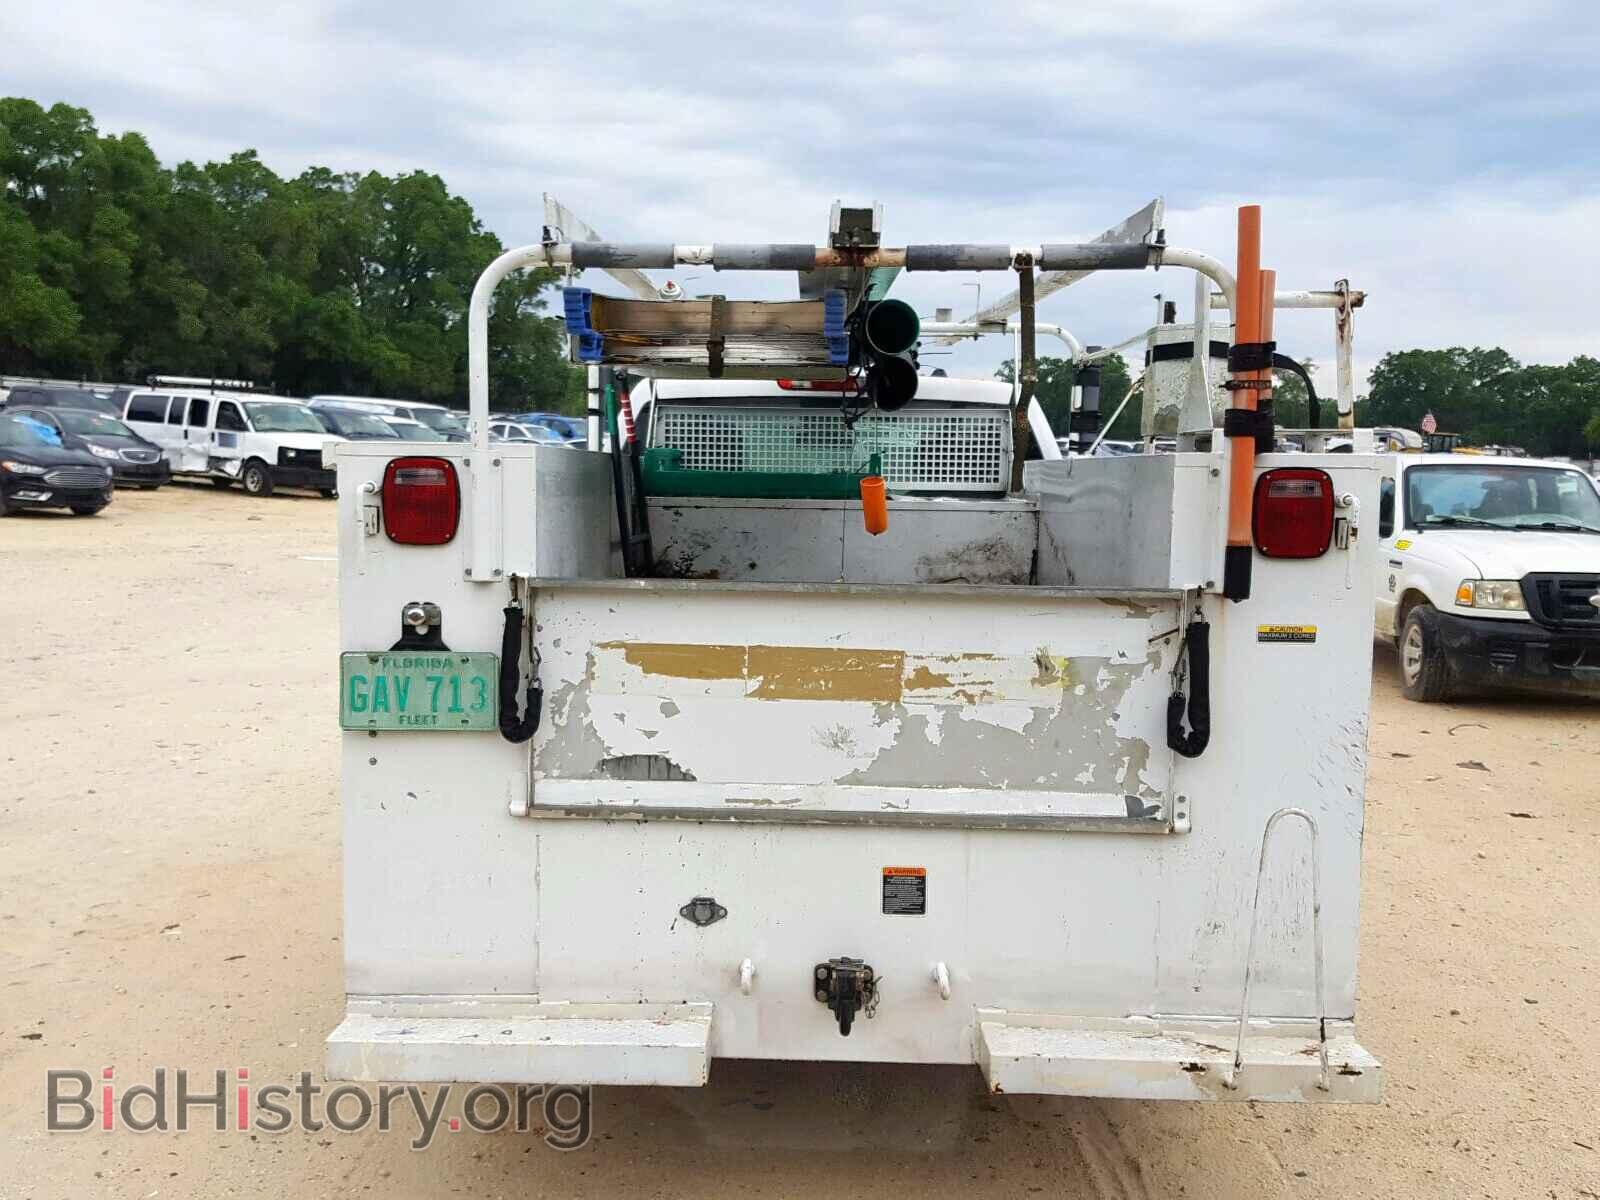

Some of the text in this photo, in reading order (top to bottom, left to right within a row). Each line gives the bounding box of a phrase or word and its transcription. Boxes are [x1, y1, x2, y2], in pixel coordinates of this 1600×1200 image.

[382, 656, 454, 669] FLORIDA
[350, 674, 489, 714] GAV 713
[399, 715, 438, 725] FLEET
